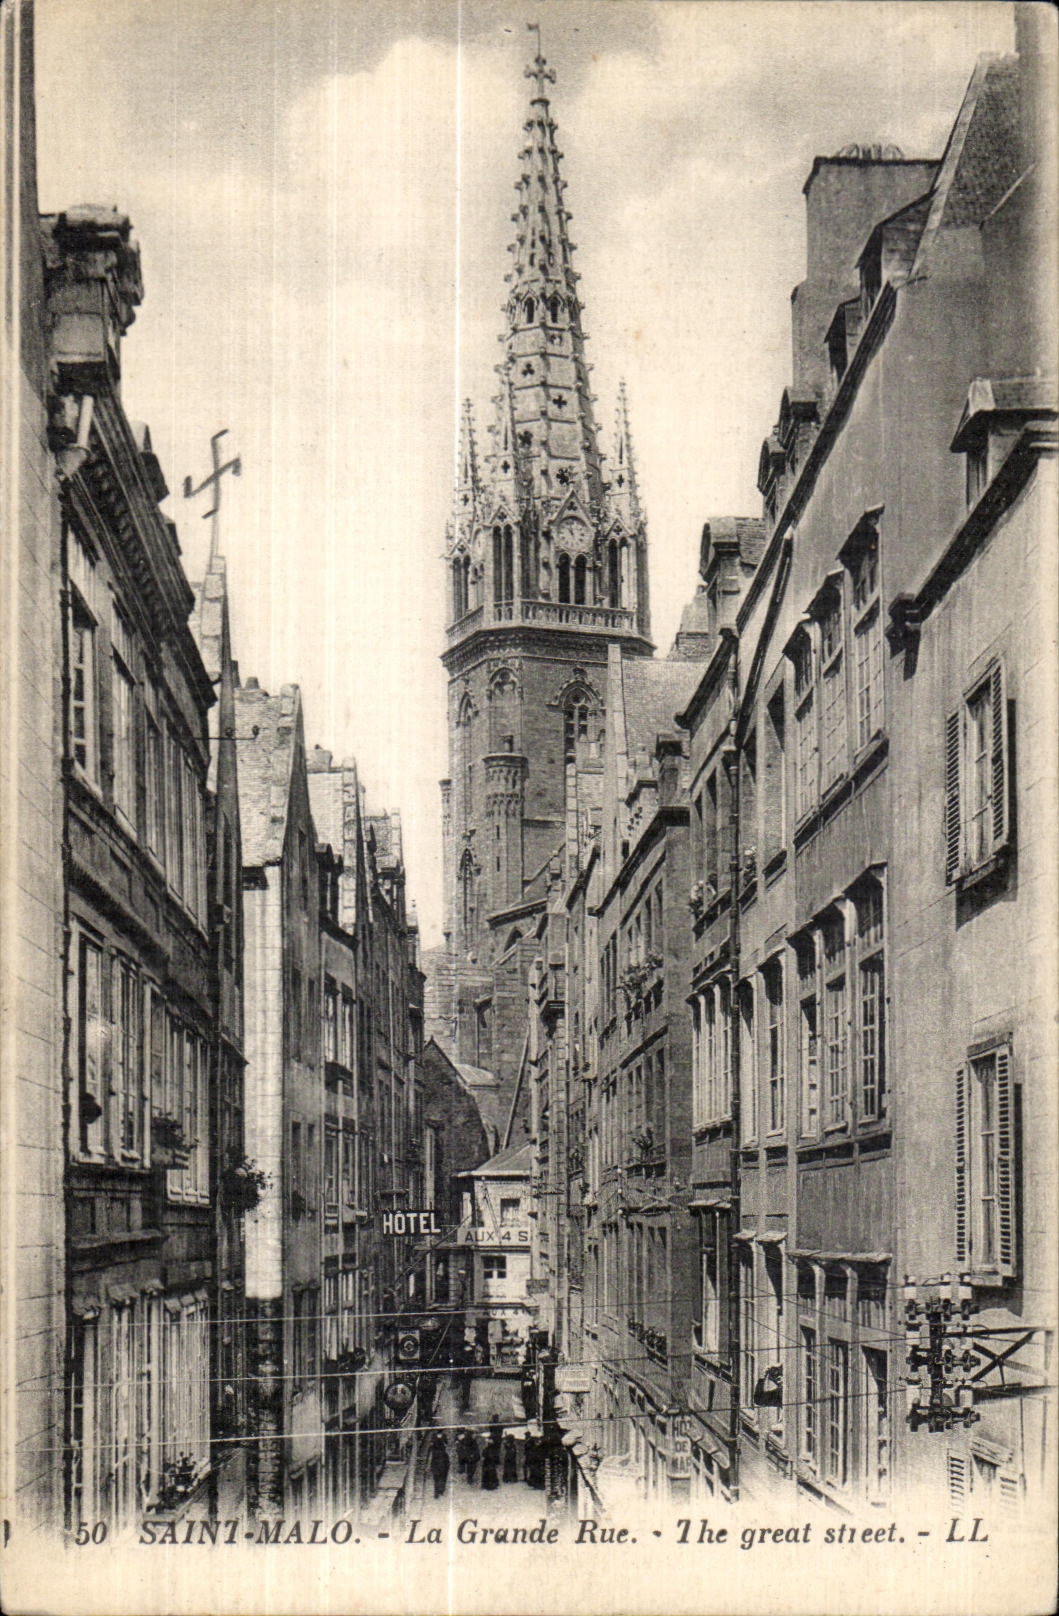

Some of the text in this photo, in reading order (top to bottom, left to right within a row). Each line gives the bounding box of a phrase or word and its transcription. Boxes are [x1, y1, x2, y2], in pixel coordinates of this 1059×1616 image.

[383, 1210, 441, 1235] HÔTEL
[465, 1231, 495, 1243] AUX
[502, 1231, 511, 1242] 4
